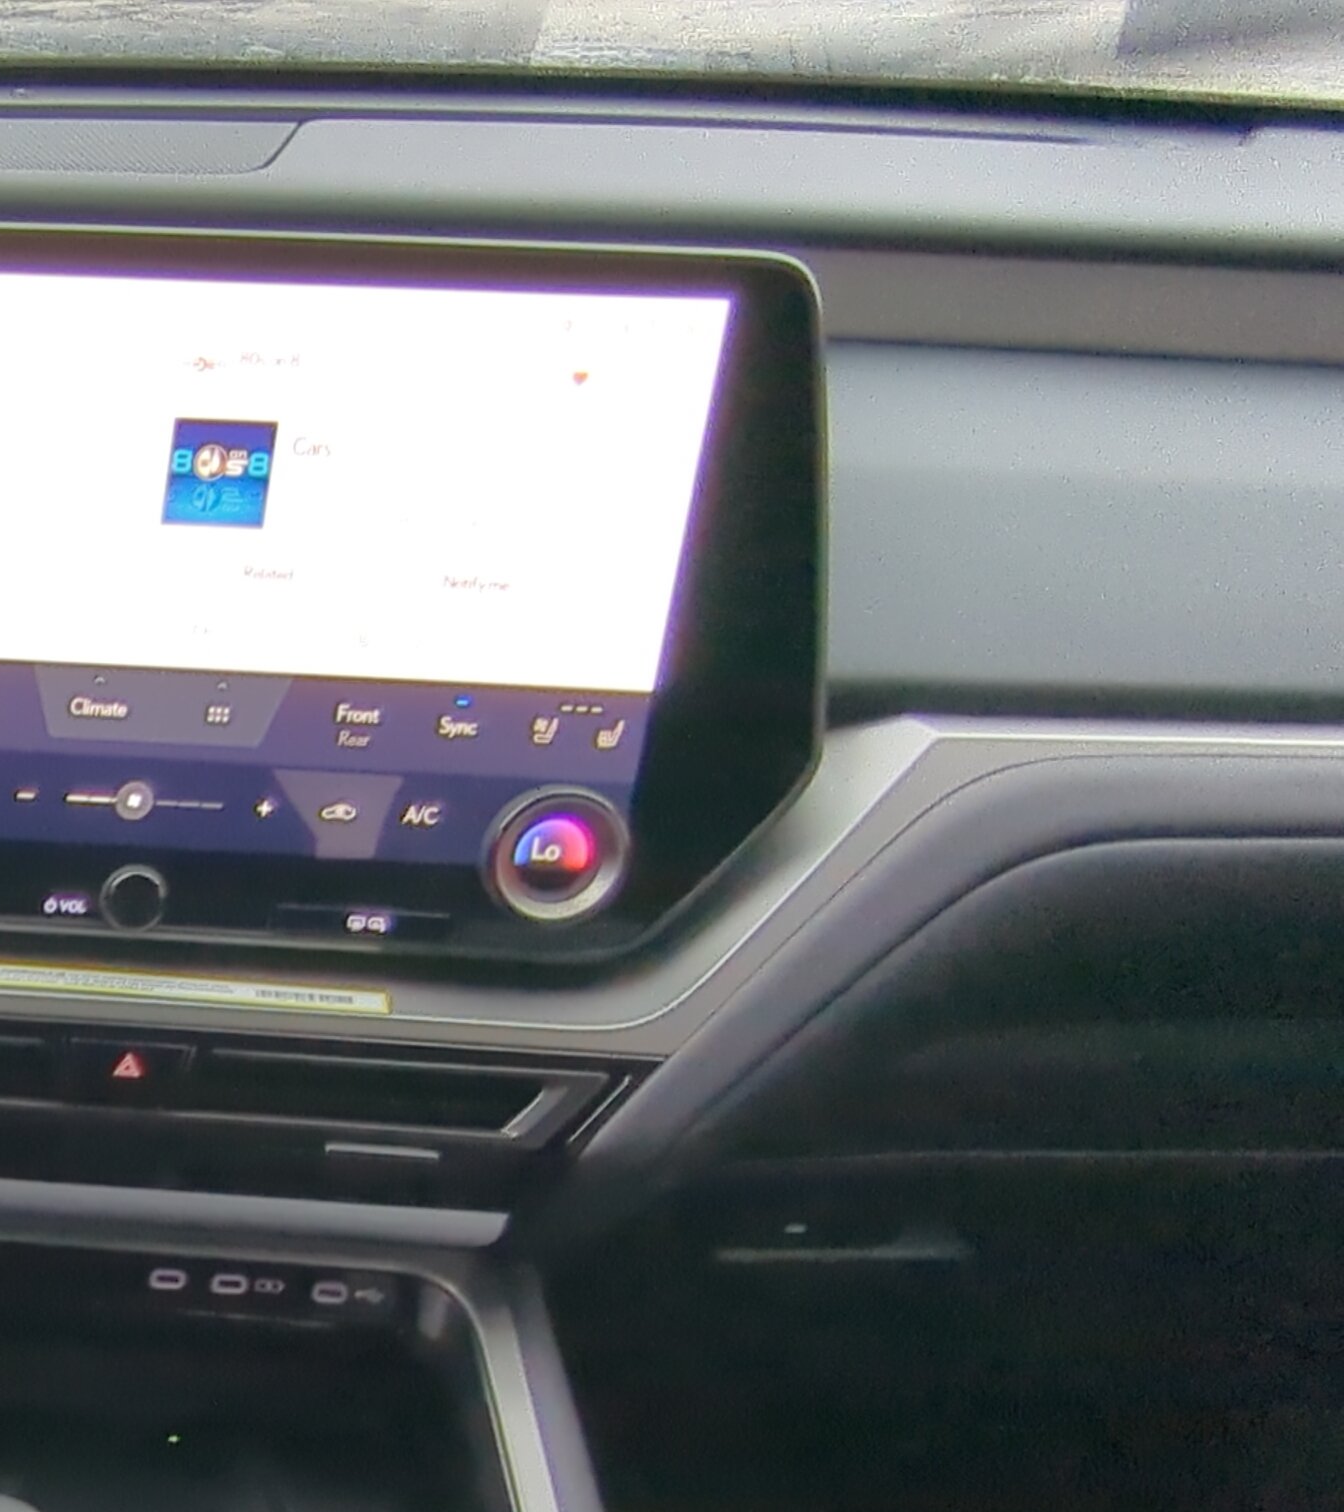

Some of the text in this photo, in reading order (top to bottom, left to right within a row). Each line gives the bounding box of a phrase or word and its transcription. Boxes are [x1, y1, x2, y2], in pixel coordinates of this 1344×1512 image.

[292, 436, 332, 458] Cars
[69, 697, 129, 719] Climate
[336, 703, 381, 725] Front
[438, 716, 479, 739] Sync
[337, 730, 371, 748] Rear
[402, 806, 440, 826] A/C
[530, 836, 561, 862] Lo
[59, 899, 88, 915] VOL
